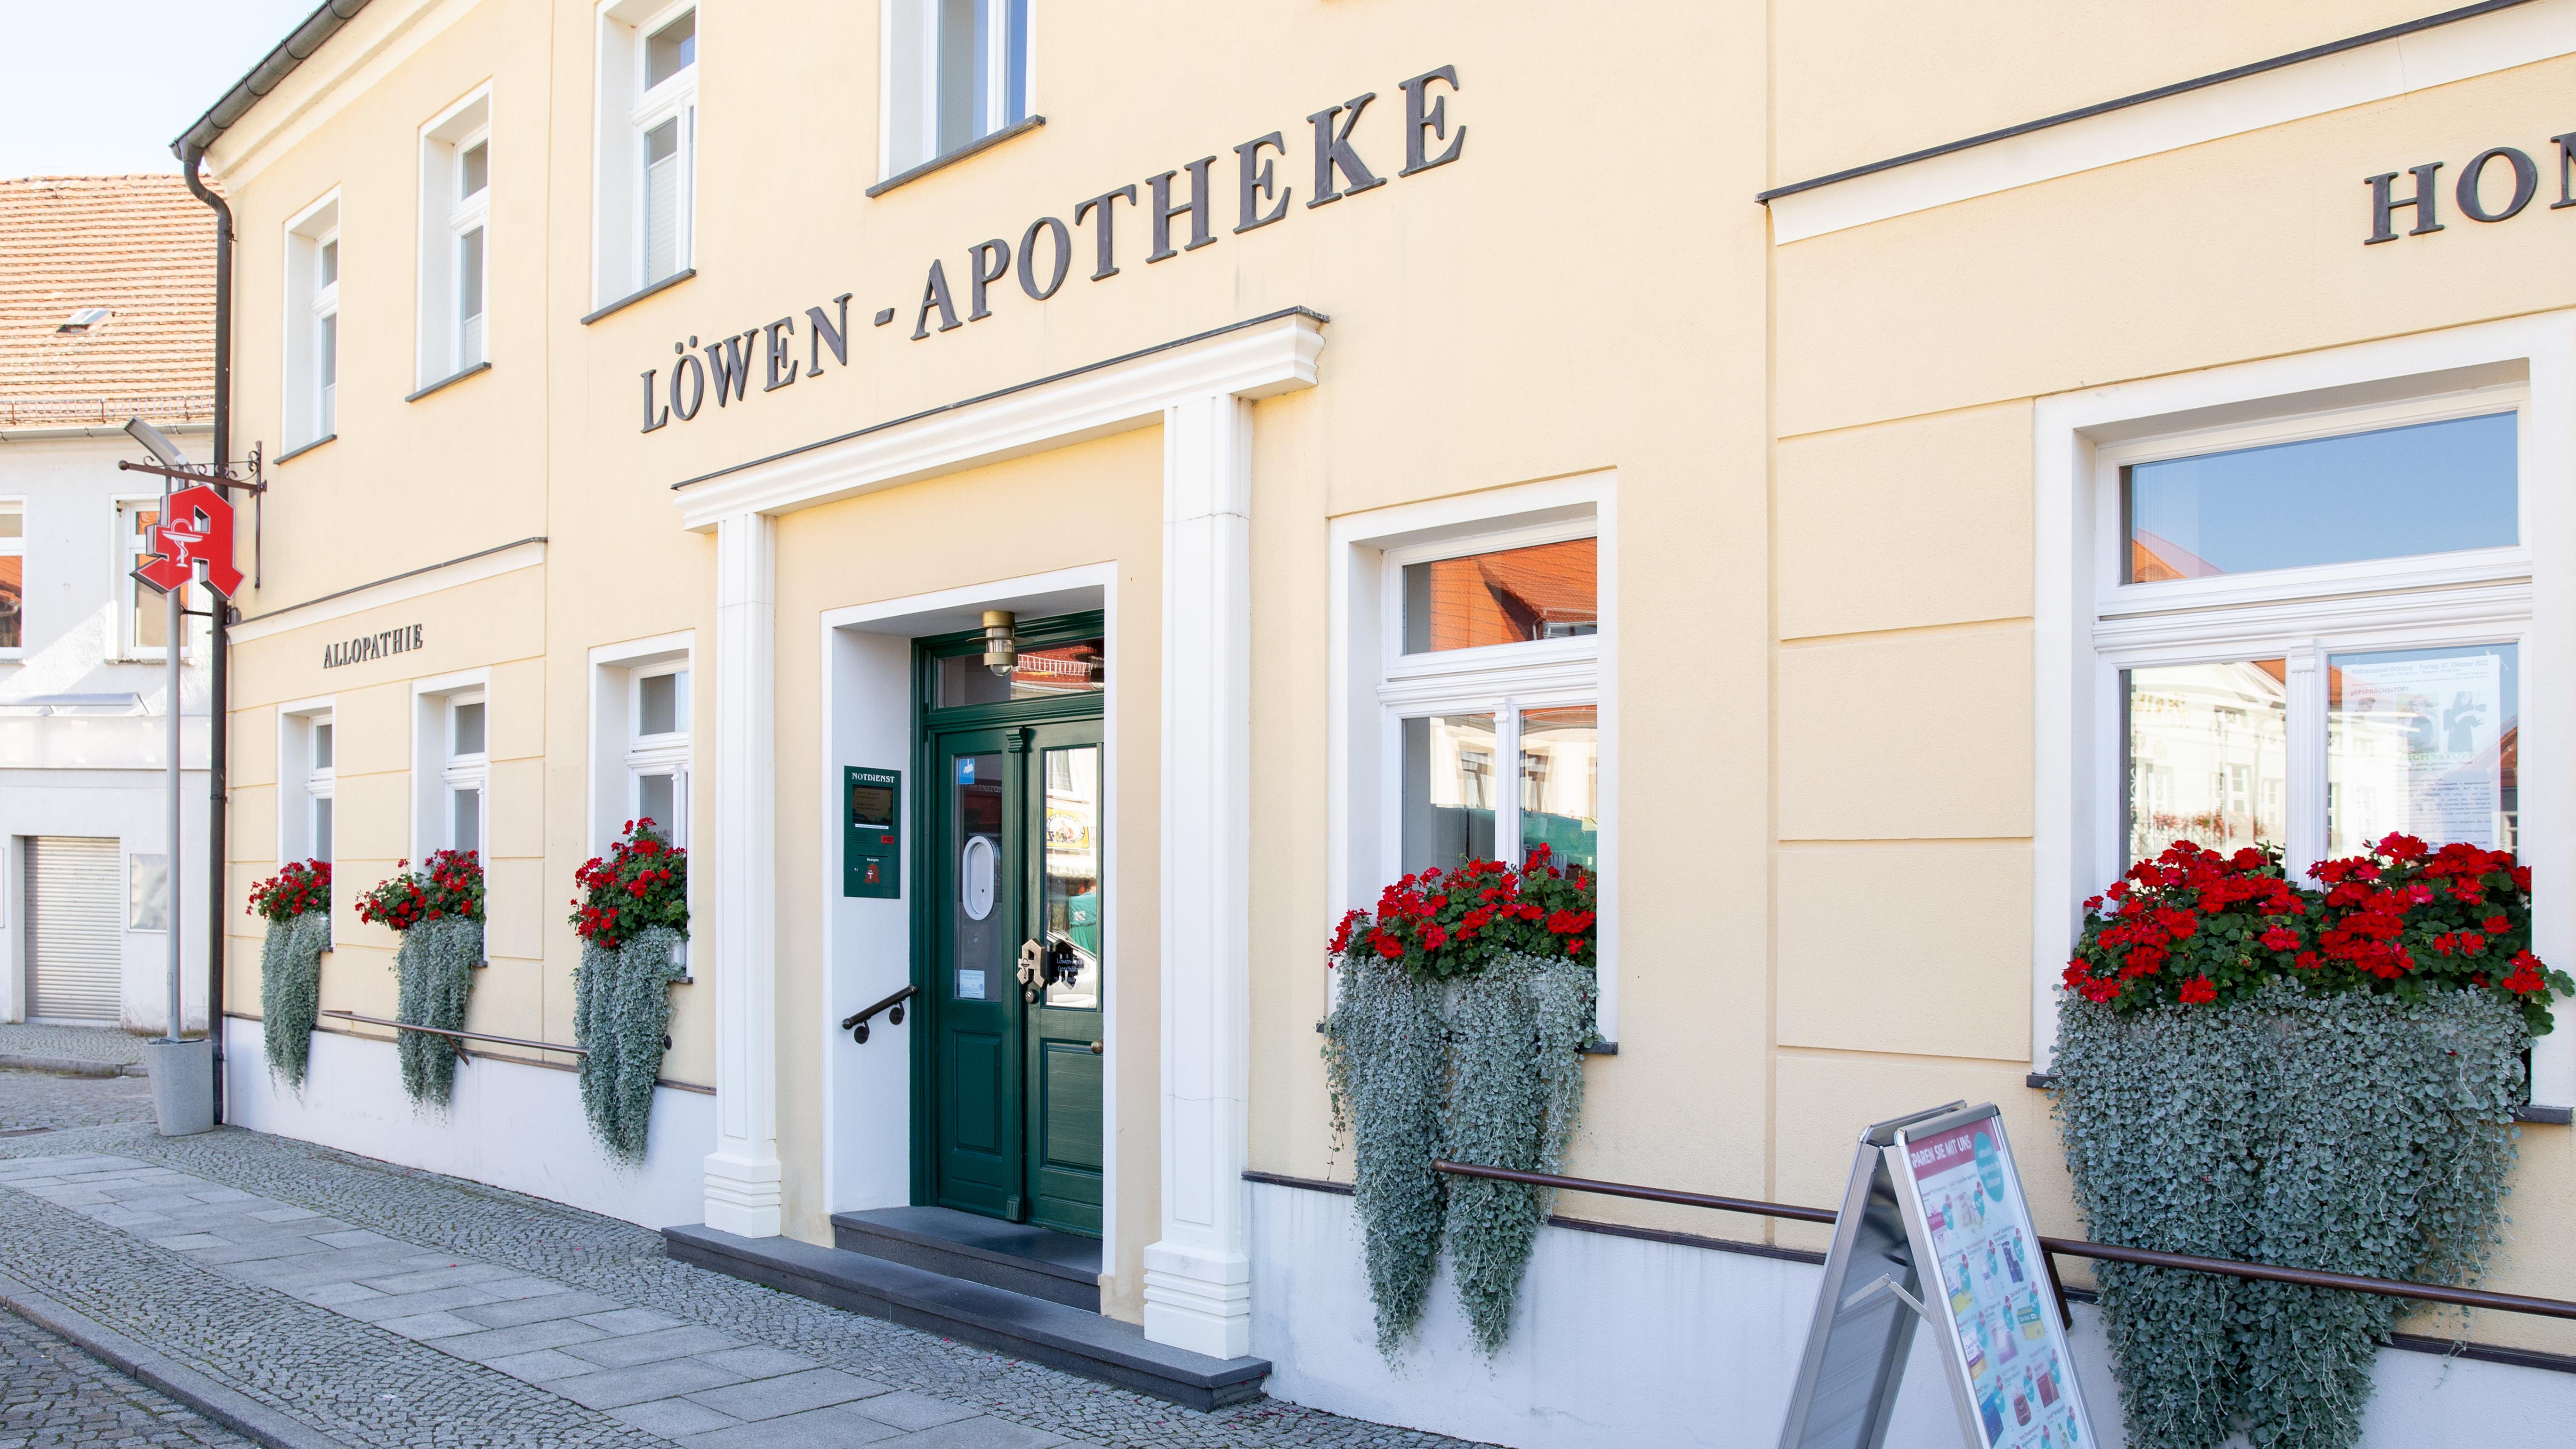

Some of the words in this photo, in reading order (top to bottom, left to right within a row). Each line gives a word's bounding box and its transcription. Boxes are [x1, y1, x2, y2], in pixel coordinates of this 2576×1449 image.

[639, 291, 853, 434] LÖWEN
[910, 64, 1468, 341] APOTHEKE
[323, 623, 423, 669] ALLOPATHIE
[852, 772, 894, 783] NOTDIENST
[1934, 1143, 1947, 1160] SIE
[1945, 1138, 1958, 1157] MIT
[1957, 1135, 1972, 1152] UNS
